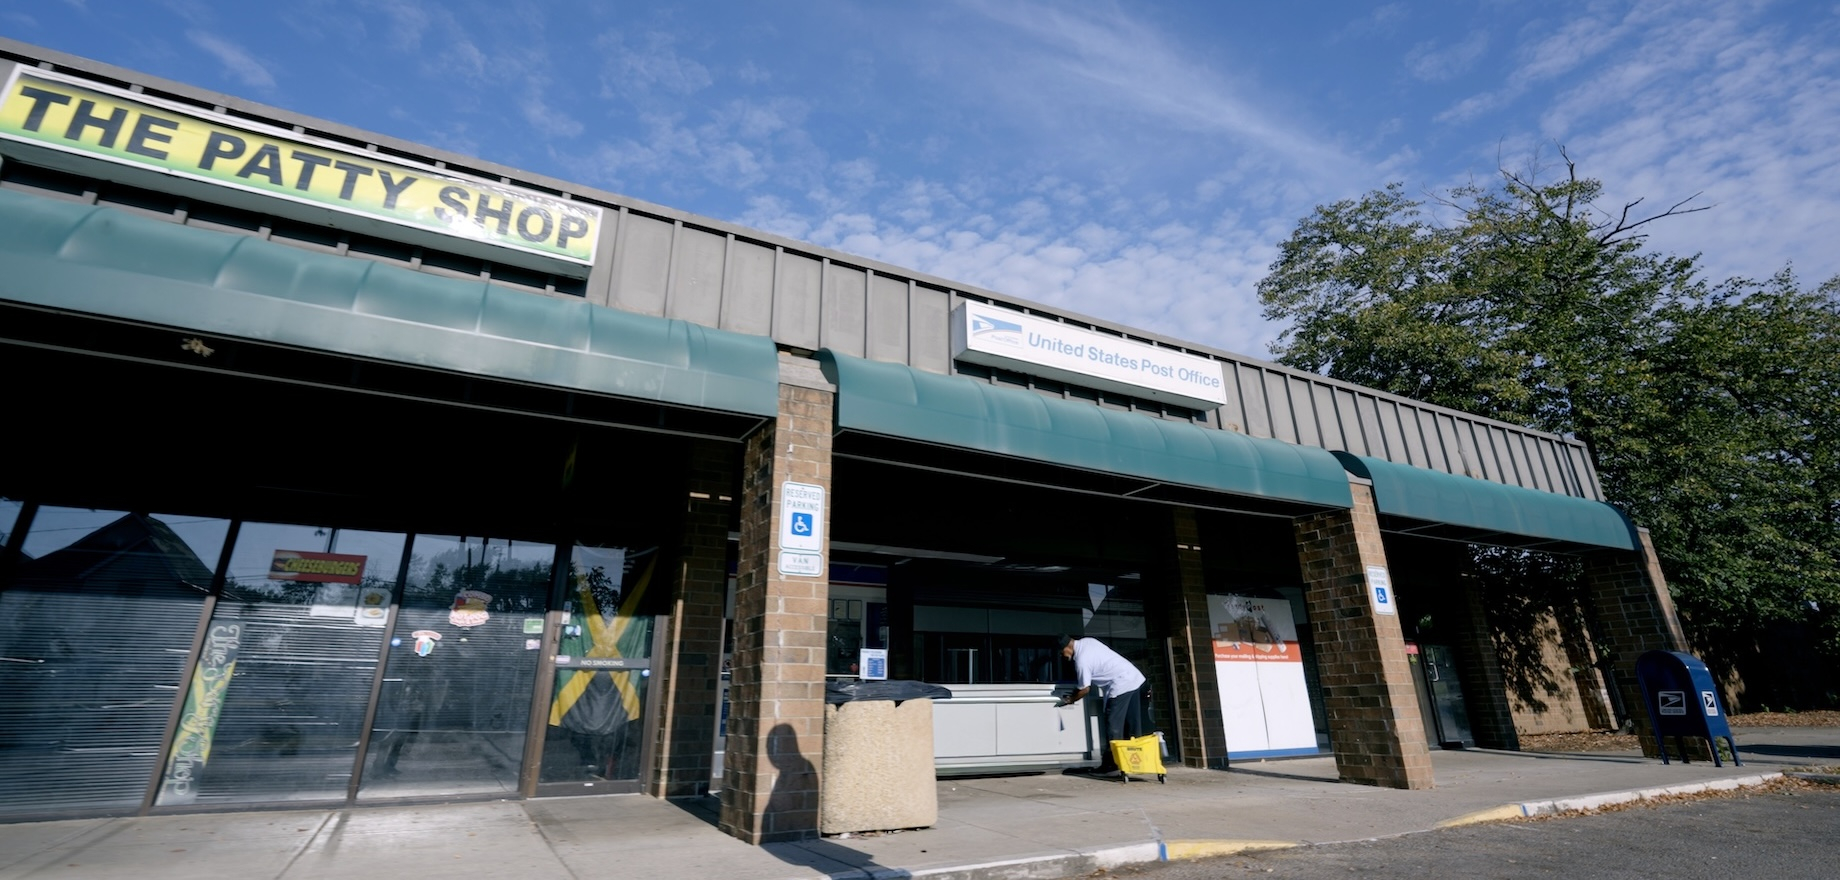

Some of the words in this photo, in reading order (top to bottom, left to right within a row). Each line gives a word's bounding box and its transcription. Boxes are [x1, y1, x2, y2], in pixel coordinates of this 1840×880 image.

[19, 85, 180, 161] THE
[197, 130, 418, 210] PATTY
[433, 185, 589, 249] SHOP
[1027, 331, 1084, 358] United
[1088, 345, 1138, 370] States
[1141, 358, 1174, 378] Post
[1178, 367, 1220, 388] Office
[785, 487, 820, 501] RESERVED
[786, 499, 819, 511] PARKING
[283, 557, 361, 576] CHEESEBURGERS
[592, 659, 624, 667] SMOKING
